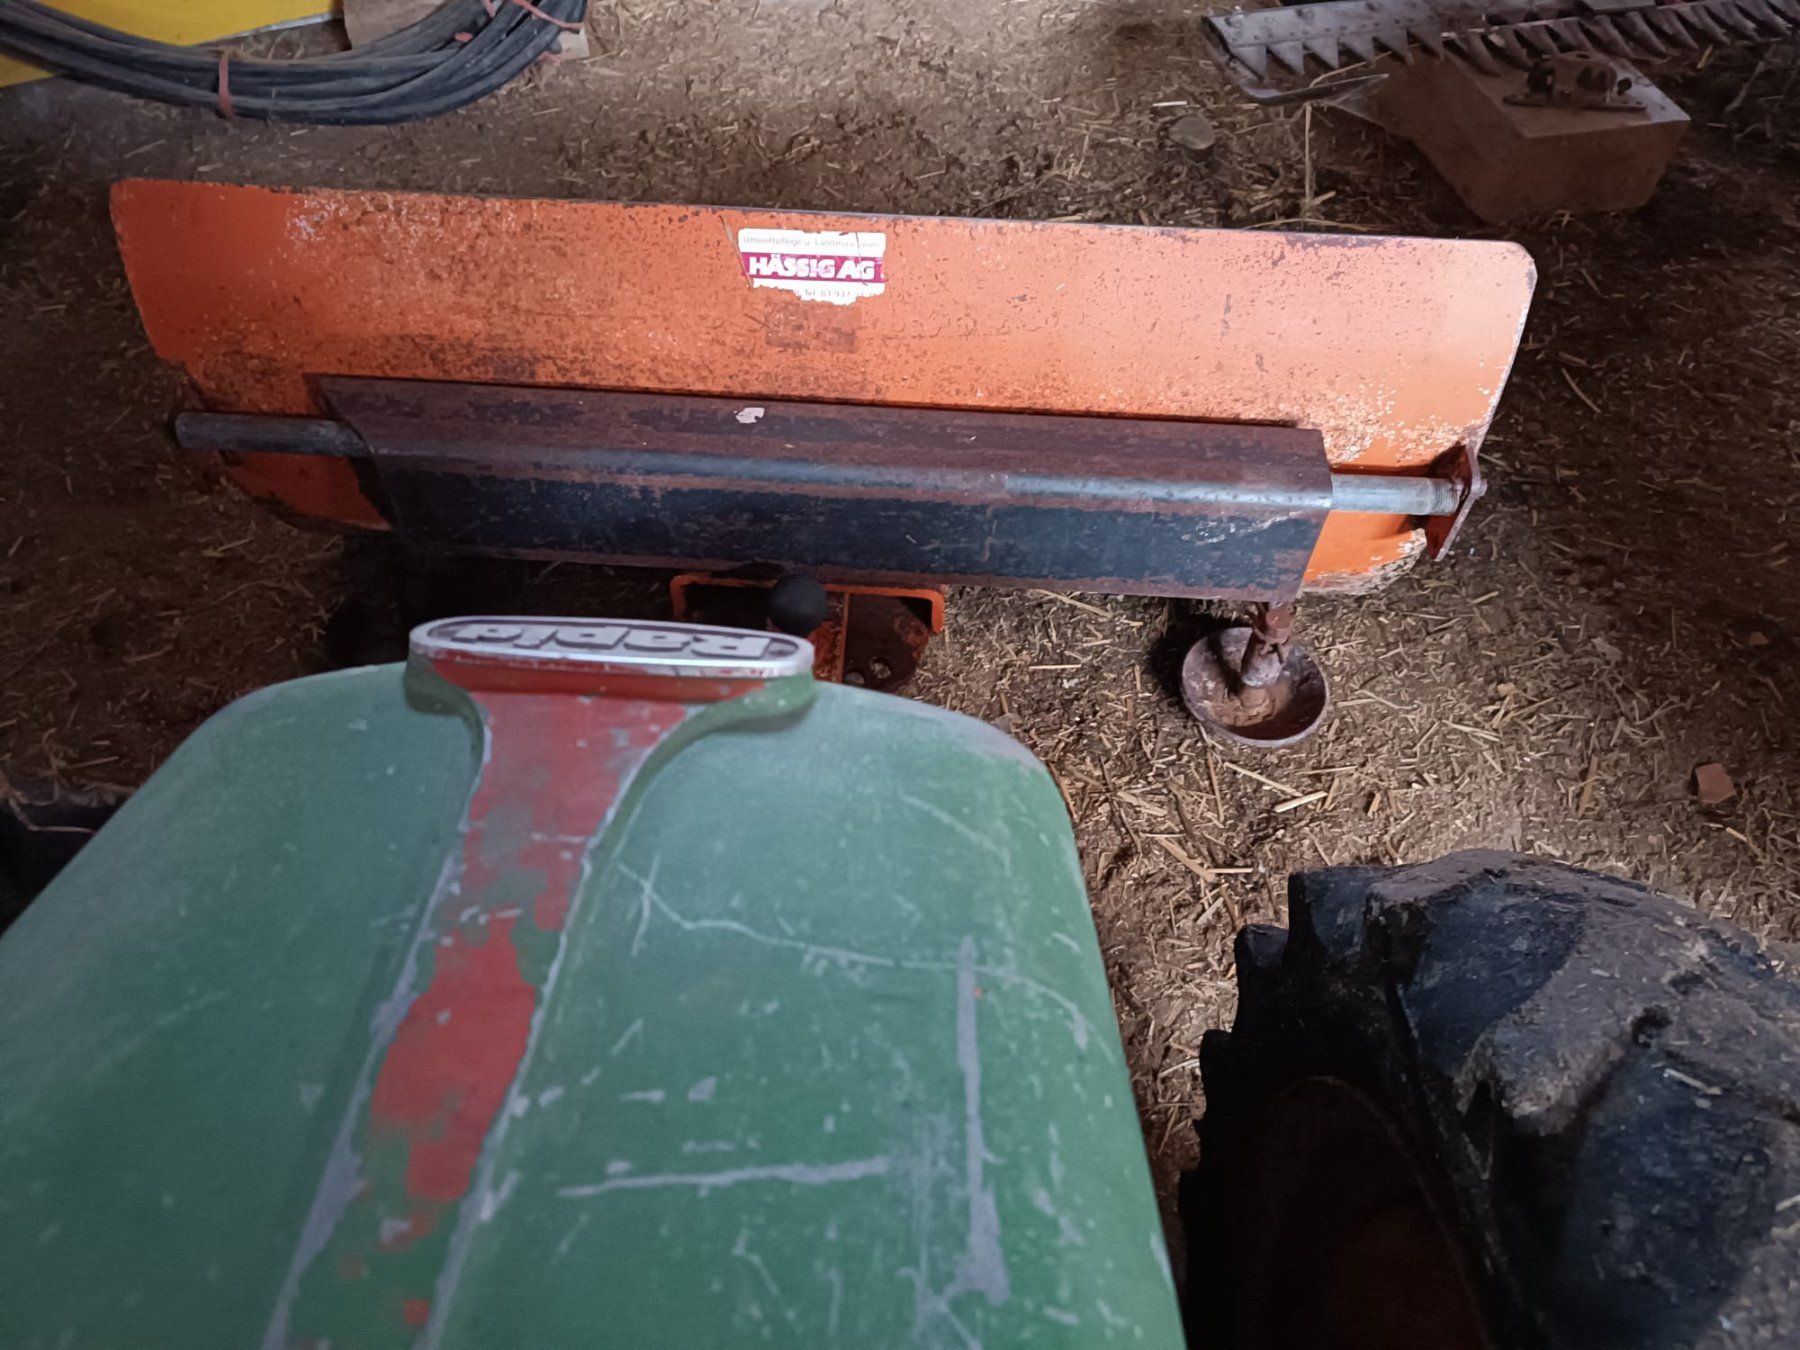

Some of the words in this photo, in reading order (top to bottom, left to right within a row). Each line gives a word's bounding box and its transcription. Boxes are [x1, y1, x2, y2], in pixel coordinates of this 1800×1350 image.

[743, 236, 802, 247] Umweltpflege
[749, 254, 835, 278] HÄSSIG
[836, 259, 875, 280] AG
[452, 623, 770, 659] Rapid
